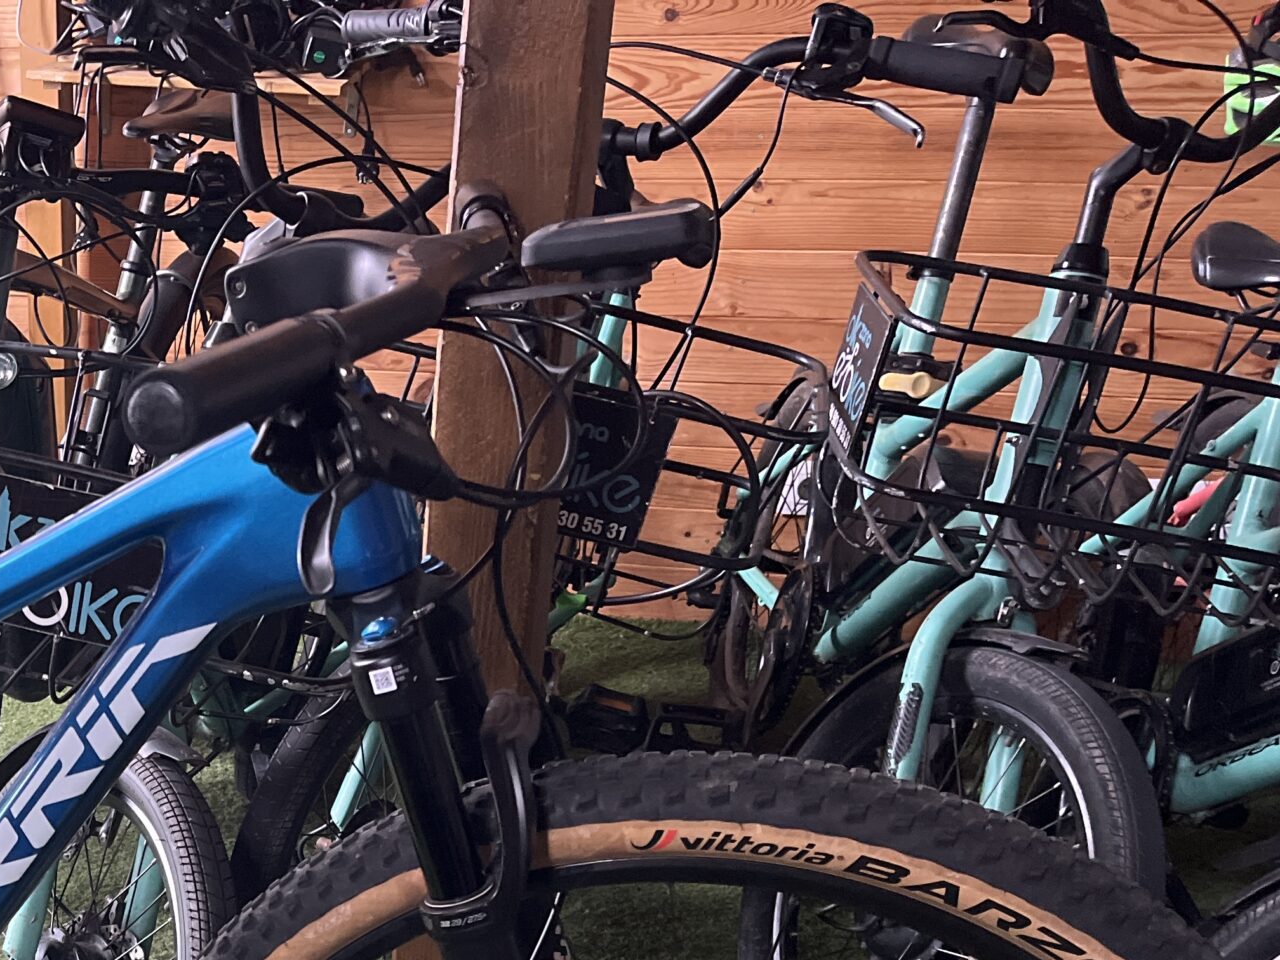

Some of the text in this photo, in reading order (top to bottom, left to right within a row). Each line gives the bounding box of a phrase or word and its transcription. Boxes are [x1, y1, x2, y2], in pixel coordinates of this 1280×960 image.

[557, 510, 628, 542] 30 55 31
[680, 831, 837, 864] vittoria
